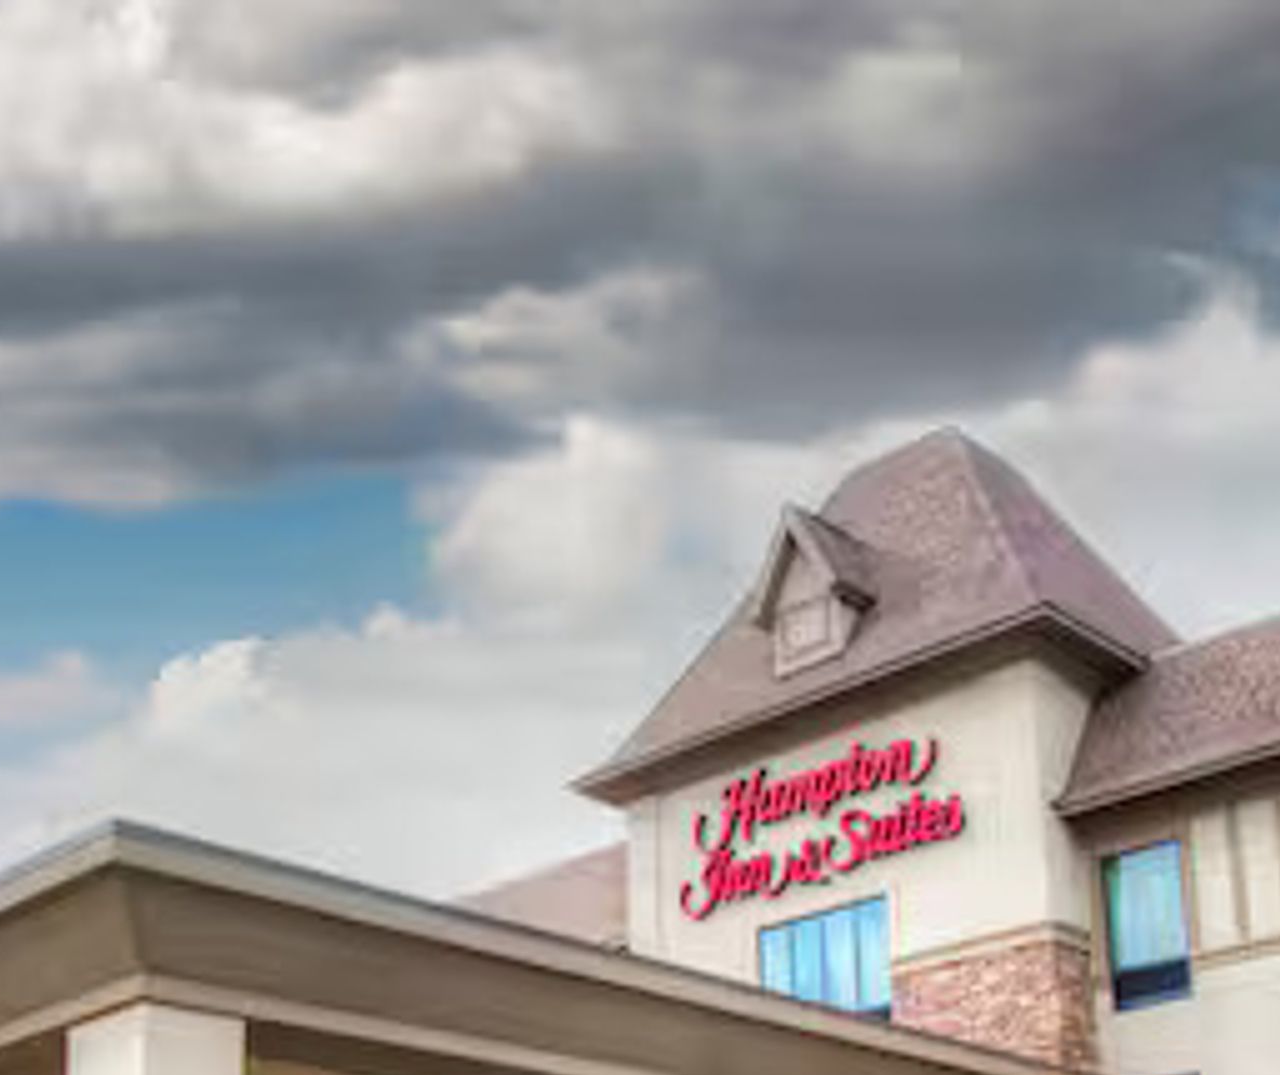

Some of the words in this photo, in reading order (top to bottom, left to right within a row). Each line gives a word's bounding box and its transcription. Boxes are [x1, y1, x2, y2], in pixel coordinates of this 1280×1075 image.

[690, 737, 938, 850] Hampton
[680, 849, 790, 921] Inn
[787, 838, 828, 882] &
[822, 791, 966, 872] Suites
